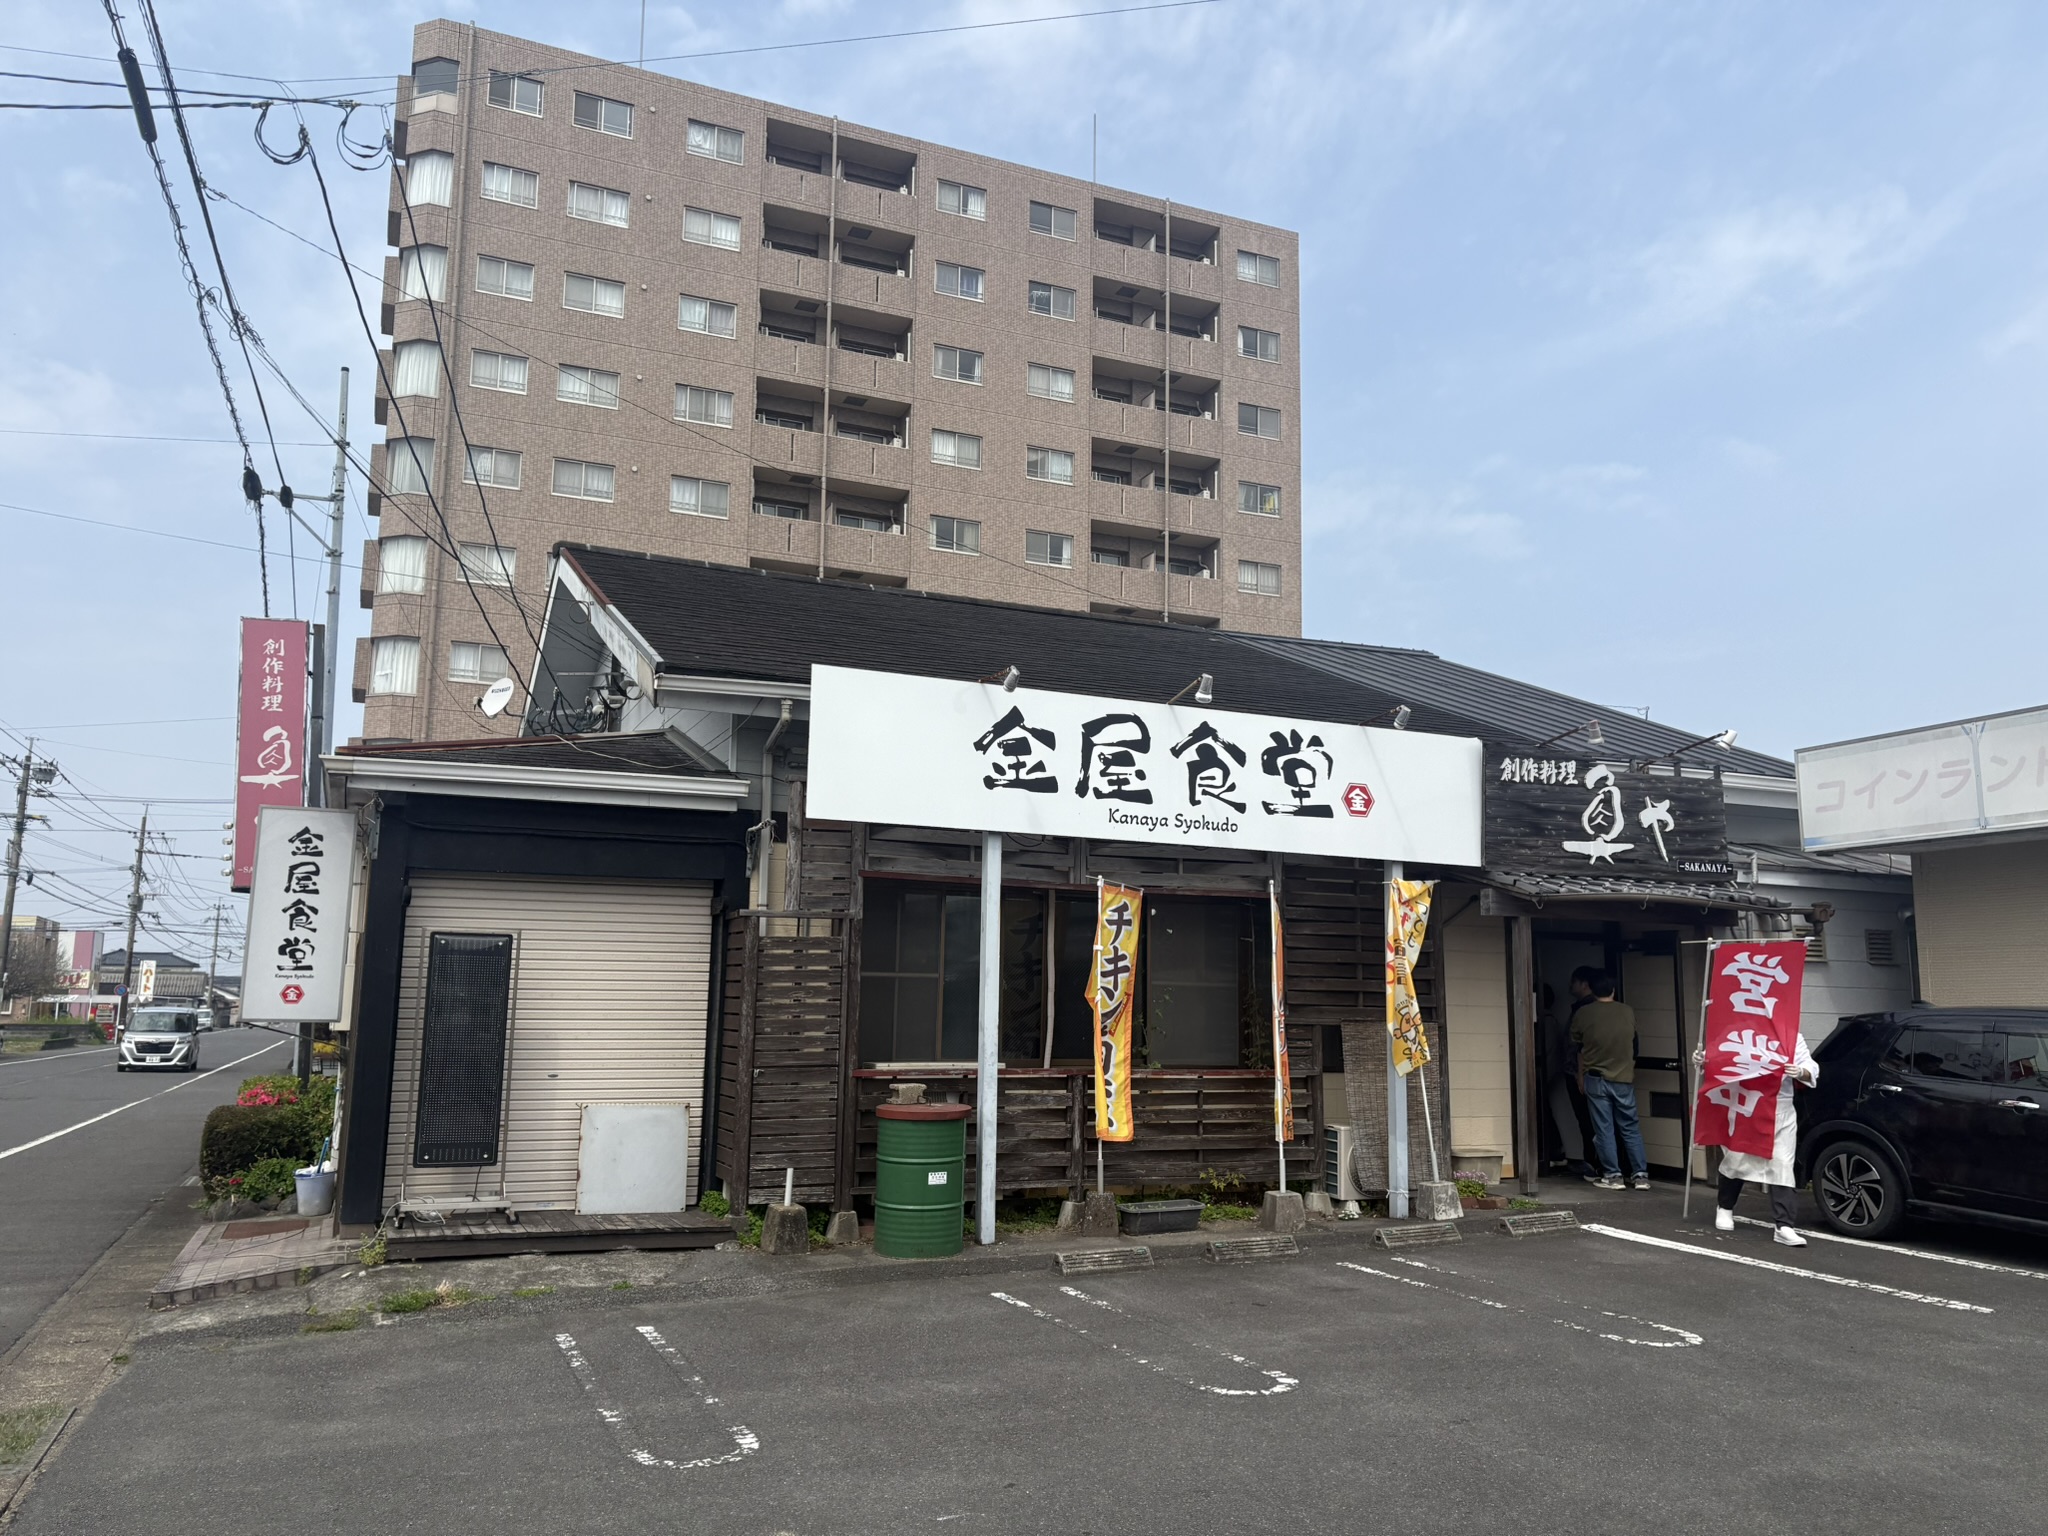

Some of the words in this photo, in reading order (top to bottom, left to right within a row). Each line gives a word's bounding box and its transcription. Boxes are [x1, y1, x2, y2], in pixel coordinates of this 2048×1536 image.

[261, 638, 285, 712] 創作料理
[240, 725, 300, 827] 魚
[973, 705, 1336, 820] 金屋食堂
[1500, 757, 1578, 785] 創作料理
[1108, 808, 1169, 830] Kanaya
[1175, 812, 1238, 834] Syokudo
[277, 826, 324, 971] 金屋食堂
[1705, 951, 1790, 1137] 営業中
